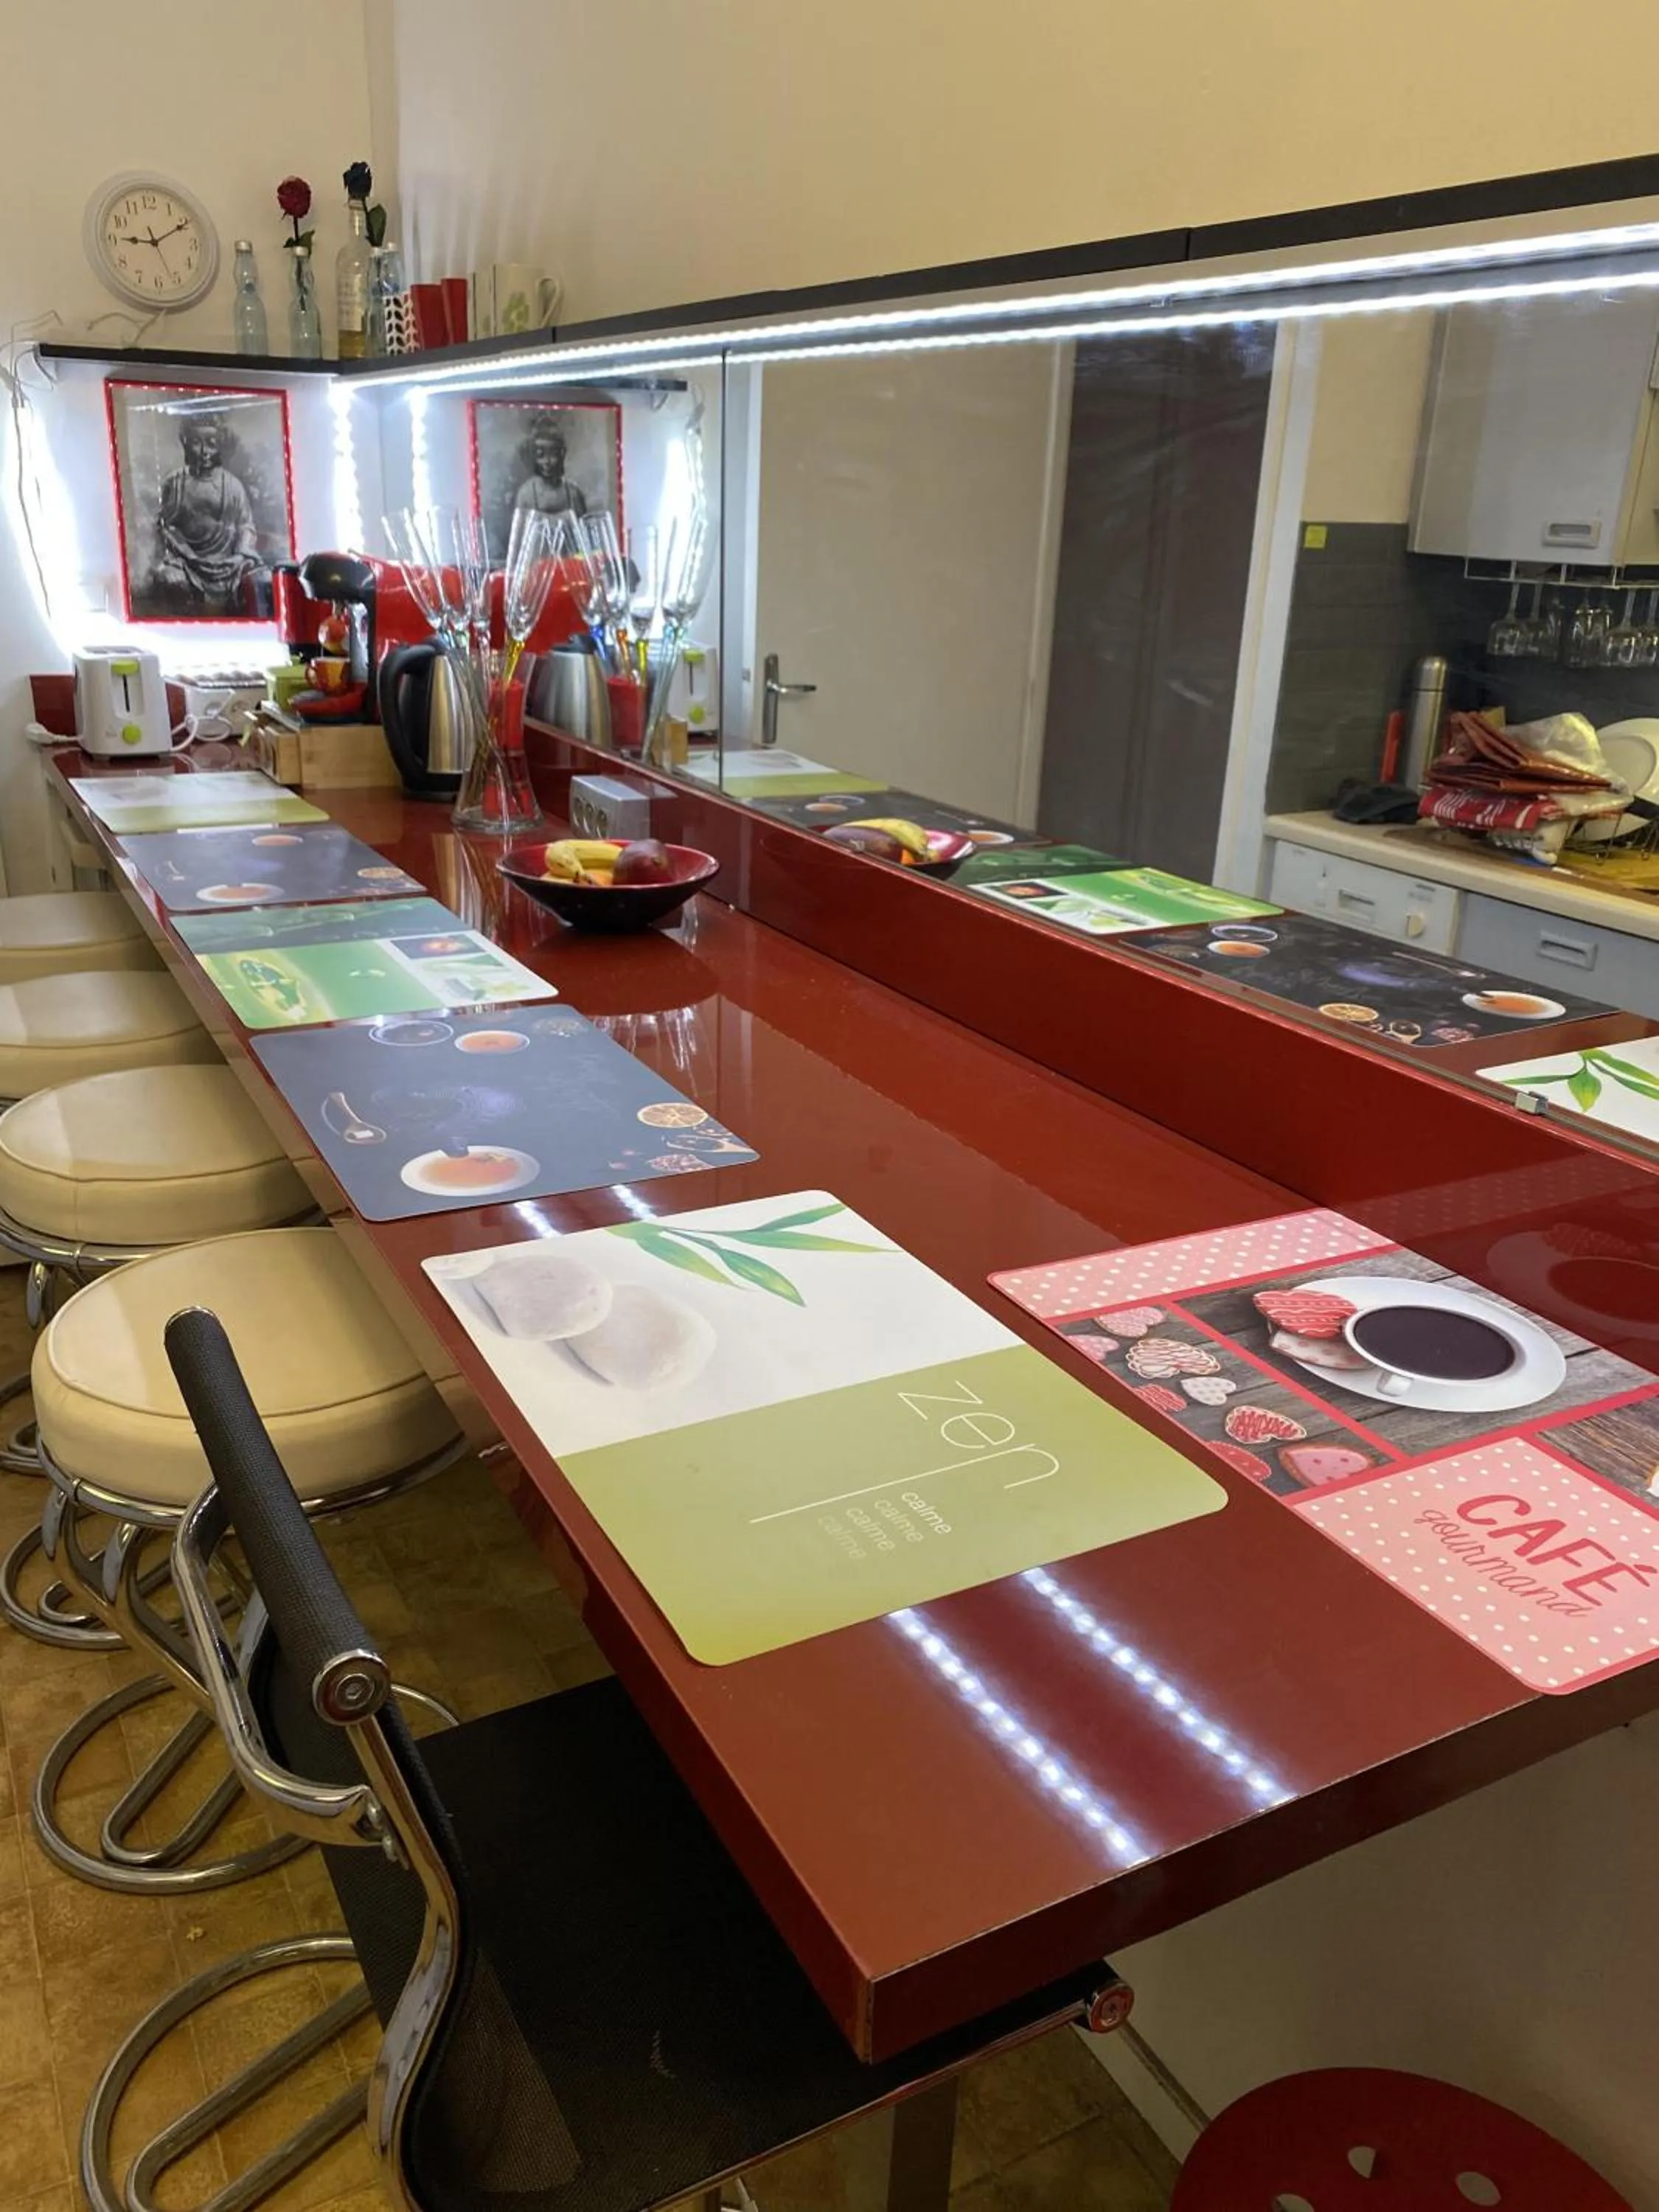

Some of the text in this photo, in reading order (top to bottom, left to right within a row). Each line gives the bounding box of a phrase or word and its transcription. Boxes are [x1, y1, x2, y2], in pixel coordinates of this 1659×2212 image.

[125, 200, 139, 215] 11
[142, 195, 157, 211] 12
[114, 215, 128, 229] 10
[189, 237, 198, 252] 3
[135, 269, 143, 284] 7
[153, 274, 164, 289] 6
[874, 1499, 924, 1544] calme
[901, 1492, 953, 1535] calme
[846, 1506, 896, 1551] calme
[818, 1514, 867, 1561] calme
[1456, 1494, 1658, 1607] CAFÉ
